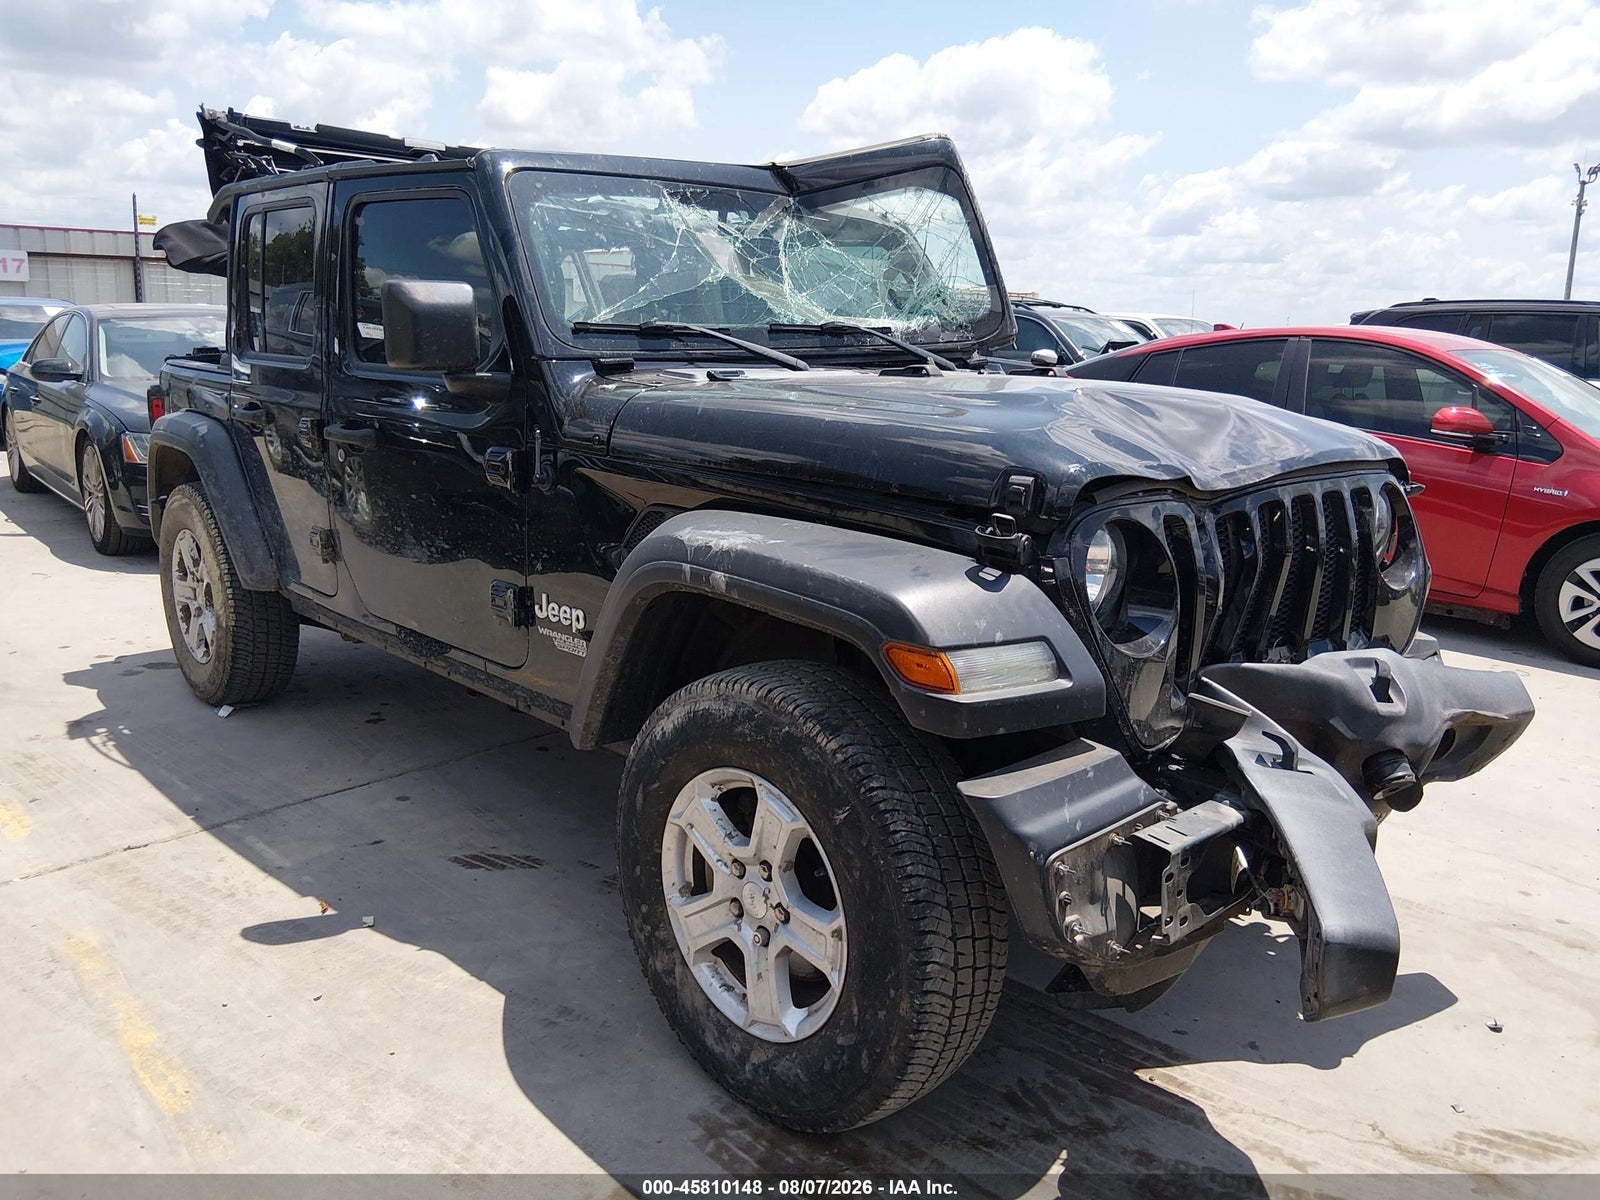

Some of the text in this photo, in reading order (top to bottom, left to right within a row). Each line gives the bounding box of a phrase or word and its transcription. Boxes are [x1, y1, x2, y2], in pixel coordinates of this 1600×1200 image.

[0, 257, 26, 274] 17
[535, 592, 585, 633] Jeep
[537, 626, 587, 648] WRANGLER
